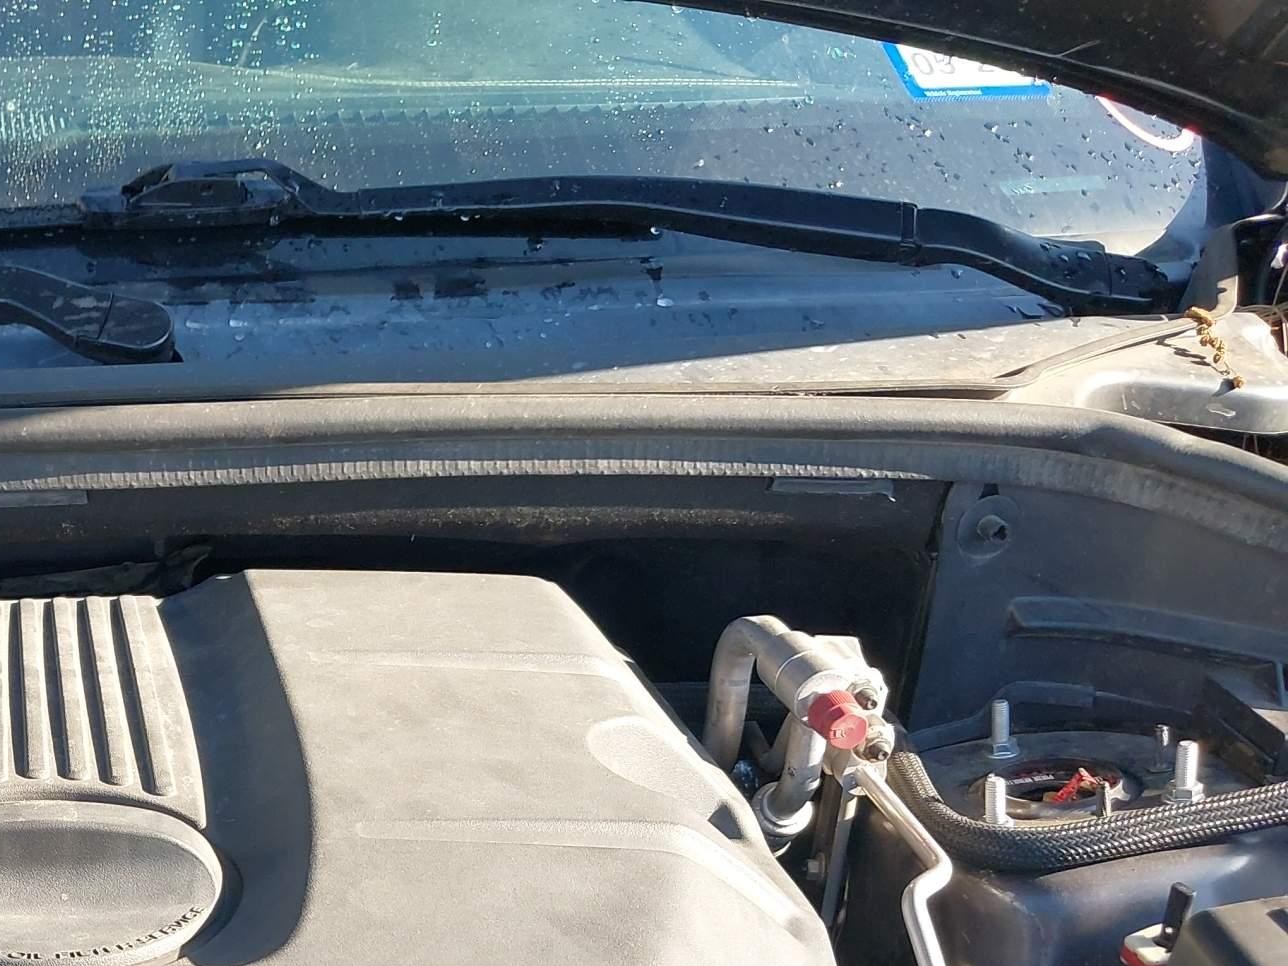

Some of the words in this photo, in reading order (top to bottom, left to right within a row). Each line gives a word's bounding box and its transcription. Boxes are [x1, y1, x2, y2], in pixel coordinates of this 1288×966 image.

[7, 951, 43, 960] OIL
[54, 941, 134, 960] FILTER
[136, 905, 205, 944] SERVICE
